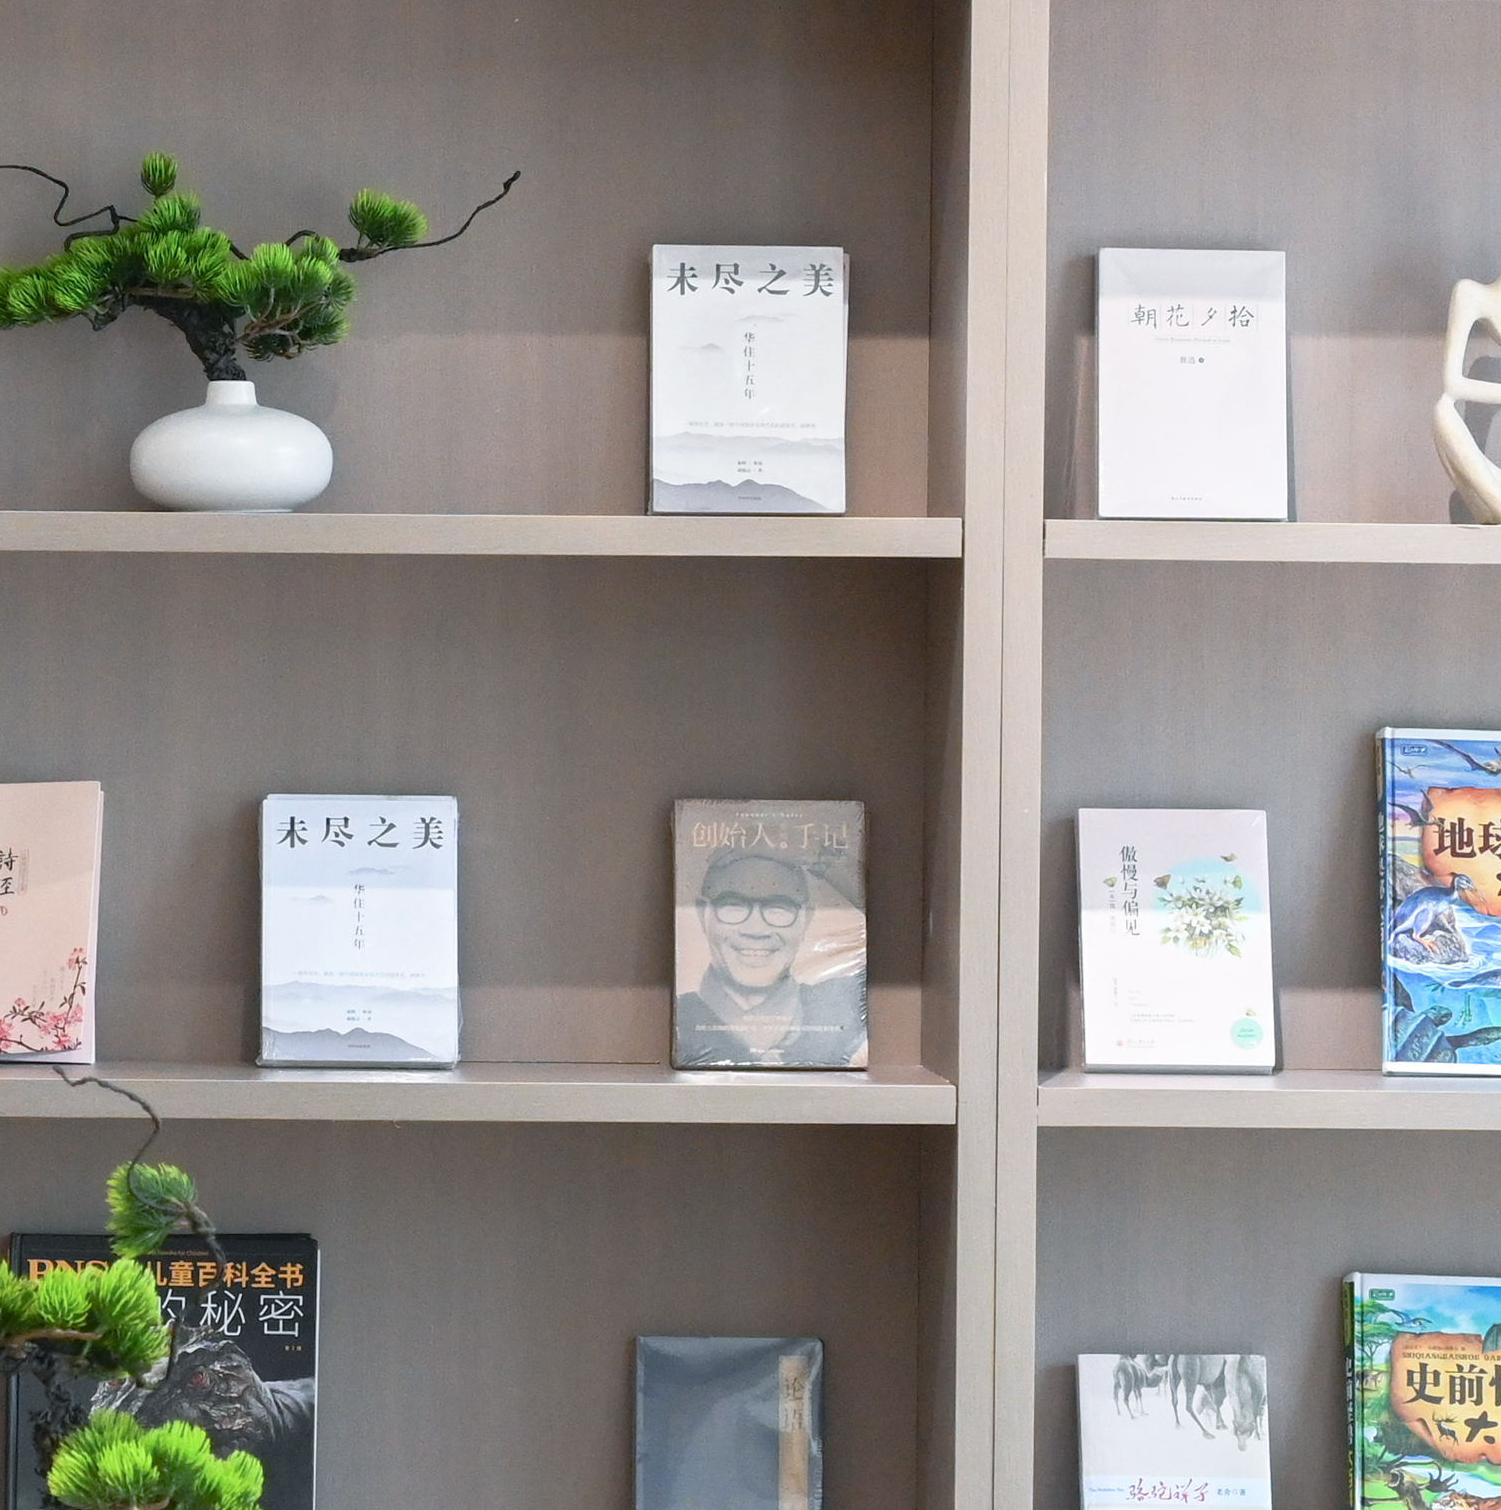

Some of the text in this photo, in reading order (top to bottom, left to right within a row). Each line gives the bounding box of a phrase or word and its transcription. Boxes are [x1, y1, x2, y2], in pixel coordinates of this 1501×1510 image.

[666, 262, 835, 298] 未尽之美
[1130, 303, 1255, 329] 朝花夕拾
[743, 331, 755, 400] 华住十五年
[1179, 356, 1196, 364] 鲁迅
[276, 816, 444, 850] 未尽之美
[692, 822, 850, 849] 创始人 手记
[1119, 844, 1141, 937] 傲慢与偏见
[352, 883, 365, 951] 华住十五年
[1125, 1477, 1210, 1504] 骆驼祥子
